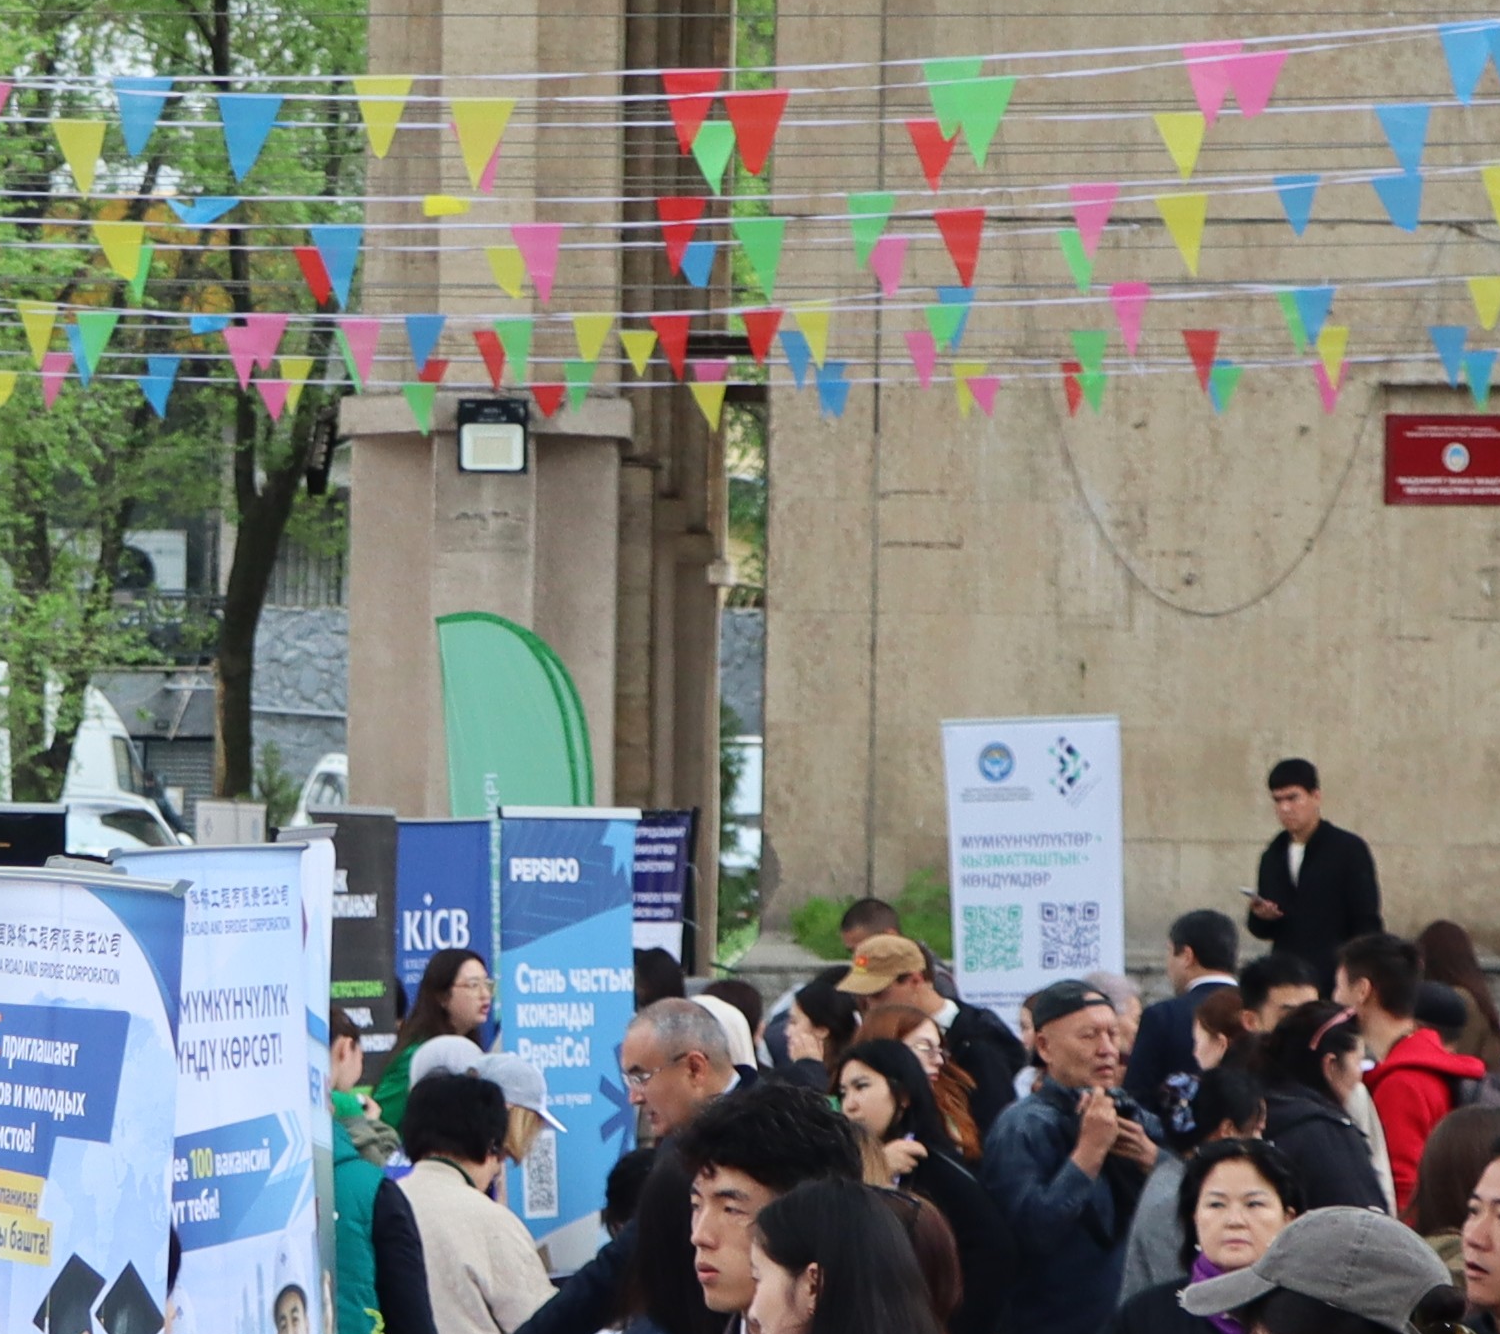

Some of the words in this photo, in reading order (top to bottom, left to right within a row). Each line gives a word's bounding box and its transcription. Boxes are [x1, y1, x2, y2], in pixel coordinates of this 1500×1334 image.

[961, 831, 1093, 849] МҮМКҮНЧҮЛҮКТӨР
[509, 857, 581, 883] PEPSICO
[961, 853, 1081, 869] КЫЗМАТТАШТЫК
[190, 885, 289, 910] 路桥工程有限责任公司
[4, 958, 22, 975] ROAD
[23, 960, 38, 977] AND
[39, 962, 64, 980] BRIDGE
[65, 964, 120, 985] CORPORATION
[515, 963, 566, 994] Стань
[516, 1002, 595, 1032] команды
[2, 1035, 79, 1069] приглашает
[220, 1033, 283, 1071] КӨРСӨТ!
[519, 1036, 591, 1078] PepsiCo!
[13, 1085, 23, 1108] и
[24, 1087, 86, 1121] молодых
[189, 1147, 214, 1179] 100
[214, 1137, 271, 1177] вакансий
[188, 1188, 220, 1222] тебя!
[10, 1220, 50, 1256] башта!
